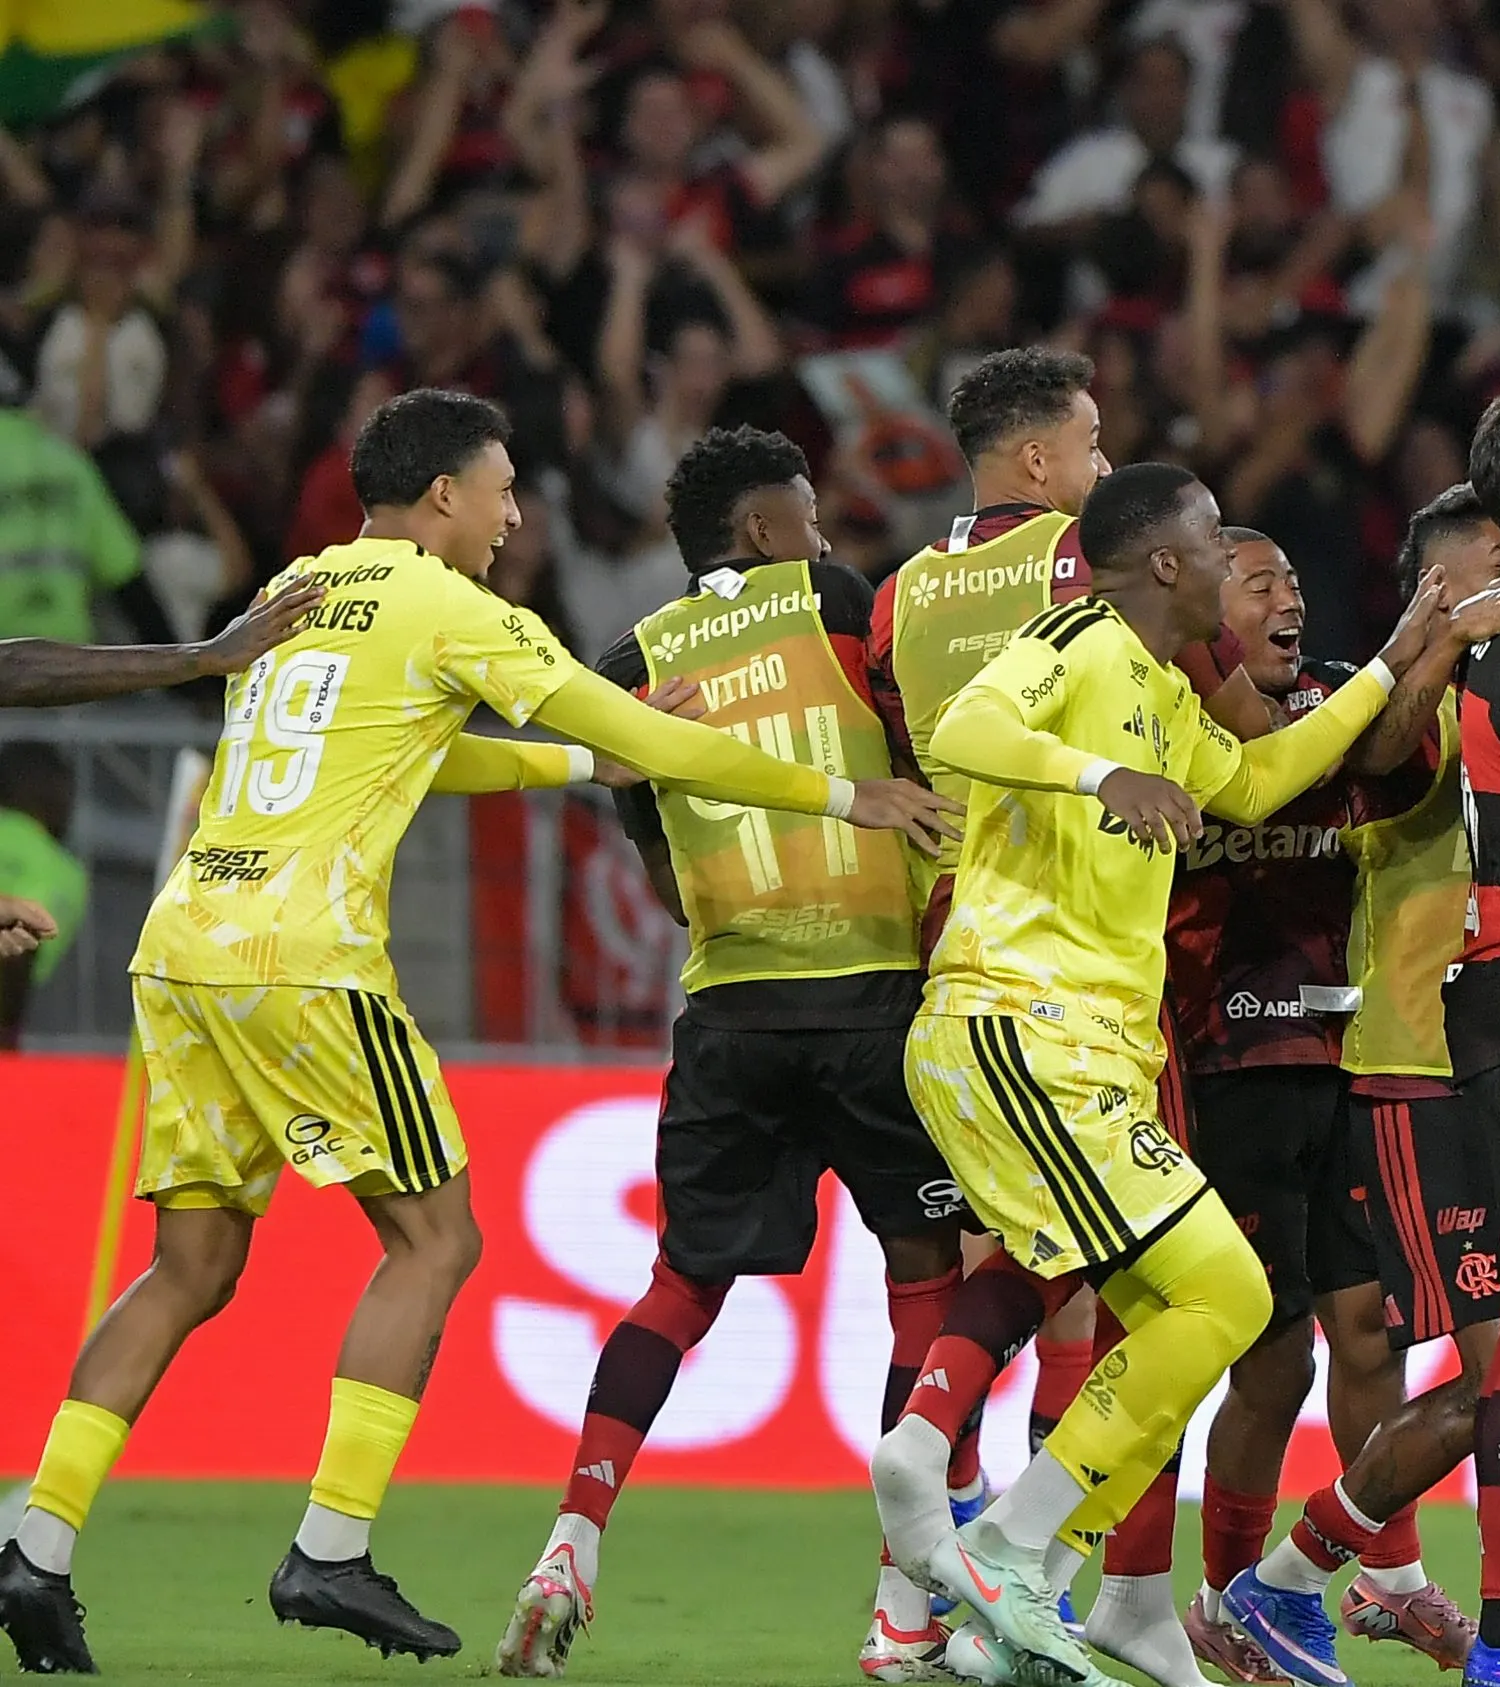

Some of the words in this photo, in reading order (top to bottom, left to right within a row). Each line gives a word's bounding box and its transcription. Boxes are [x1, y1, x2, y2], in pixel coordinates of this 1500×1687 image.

[310, 563, 395, 589] pvida
[502, 614, 556, 667] Shoee
[689, 590, 822, 649] Hapvida
[948, 628, 1017, 655] ASSI
[315, 663, 337, 708] TEXACO
[700, 653, 789, 713] VITÃO
[821, 715, 833, 761] TEXACO
[1186, 822, 1342, 871] Betano
[291, 1136, 345, 1165] GAC
[1436, 1205, 1488, 1235] Wap
